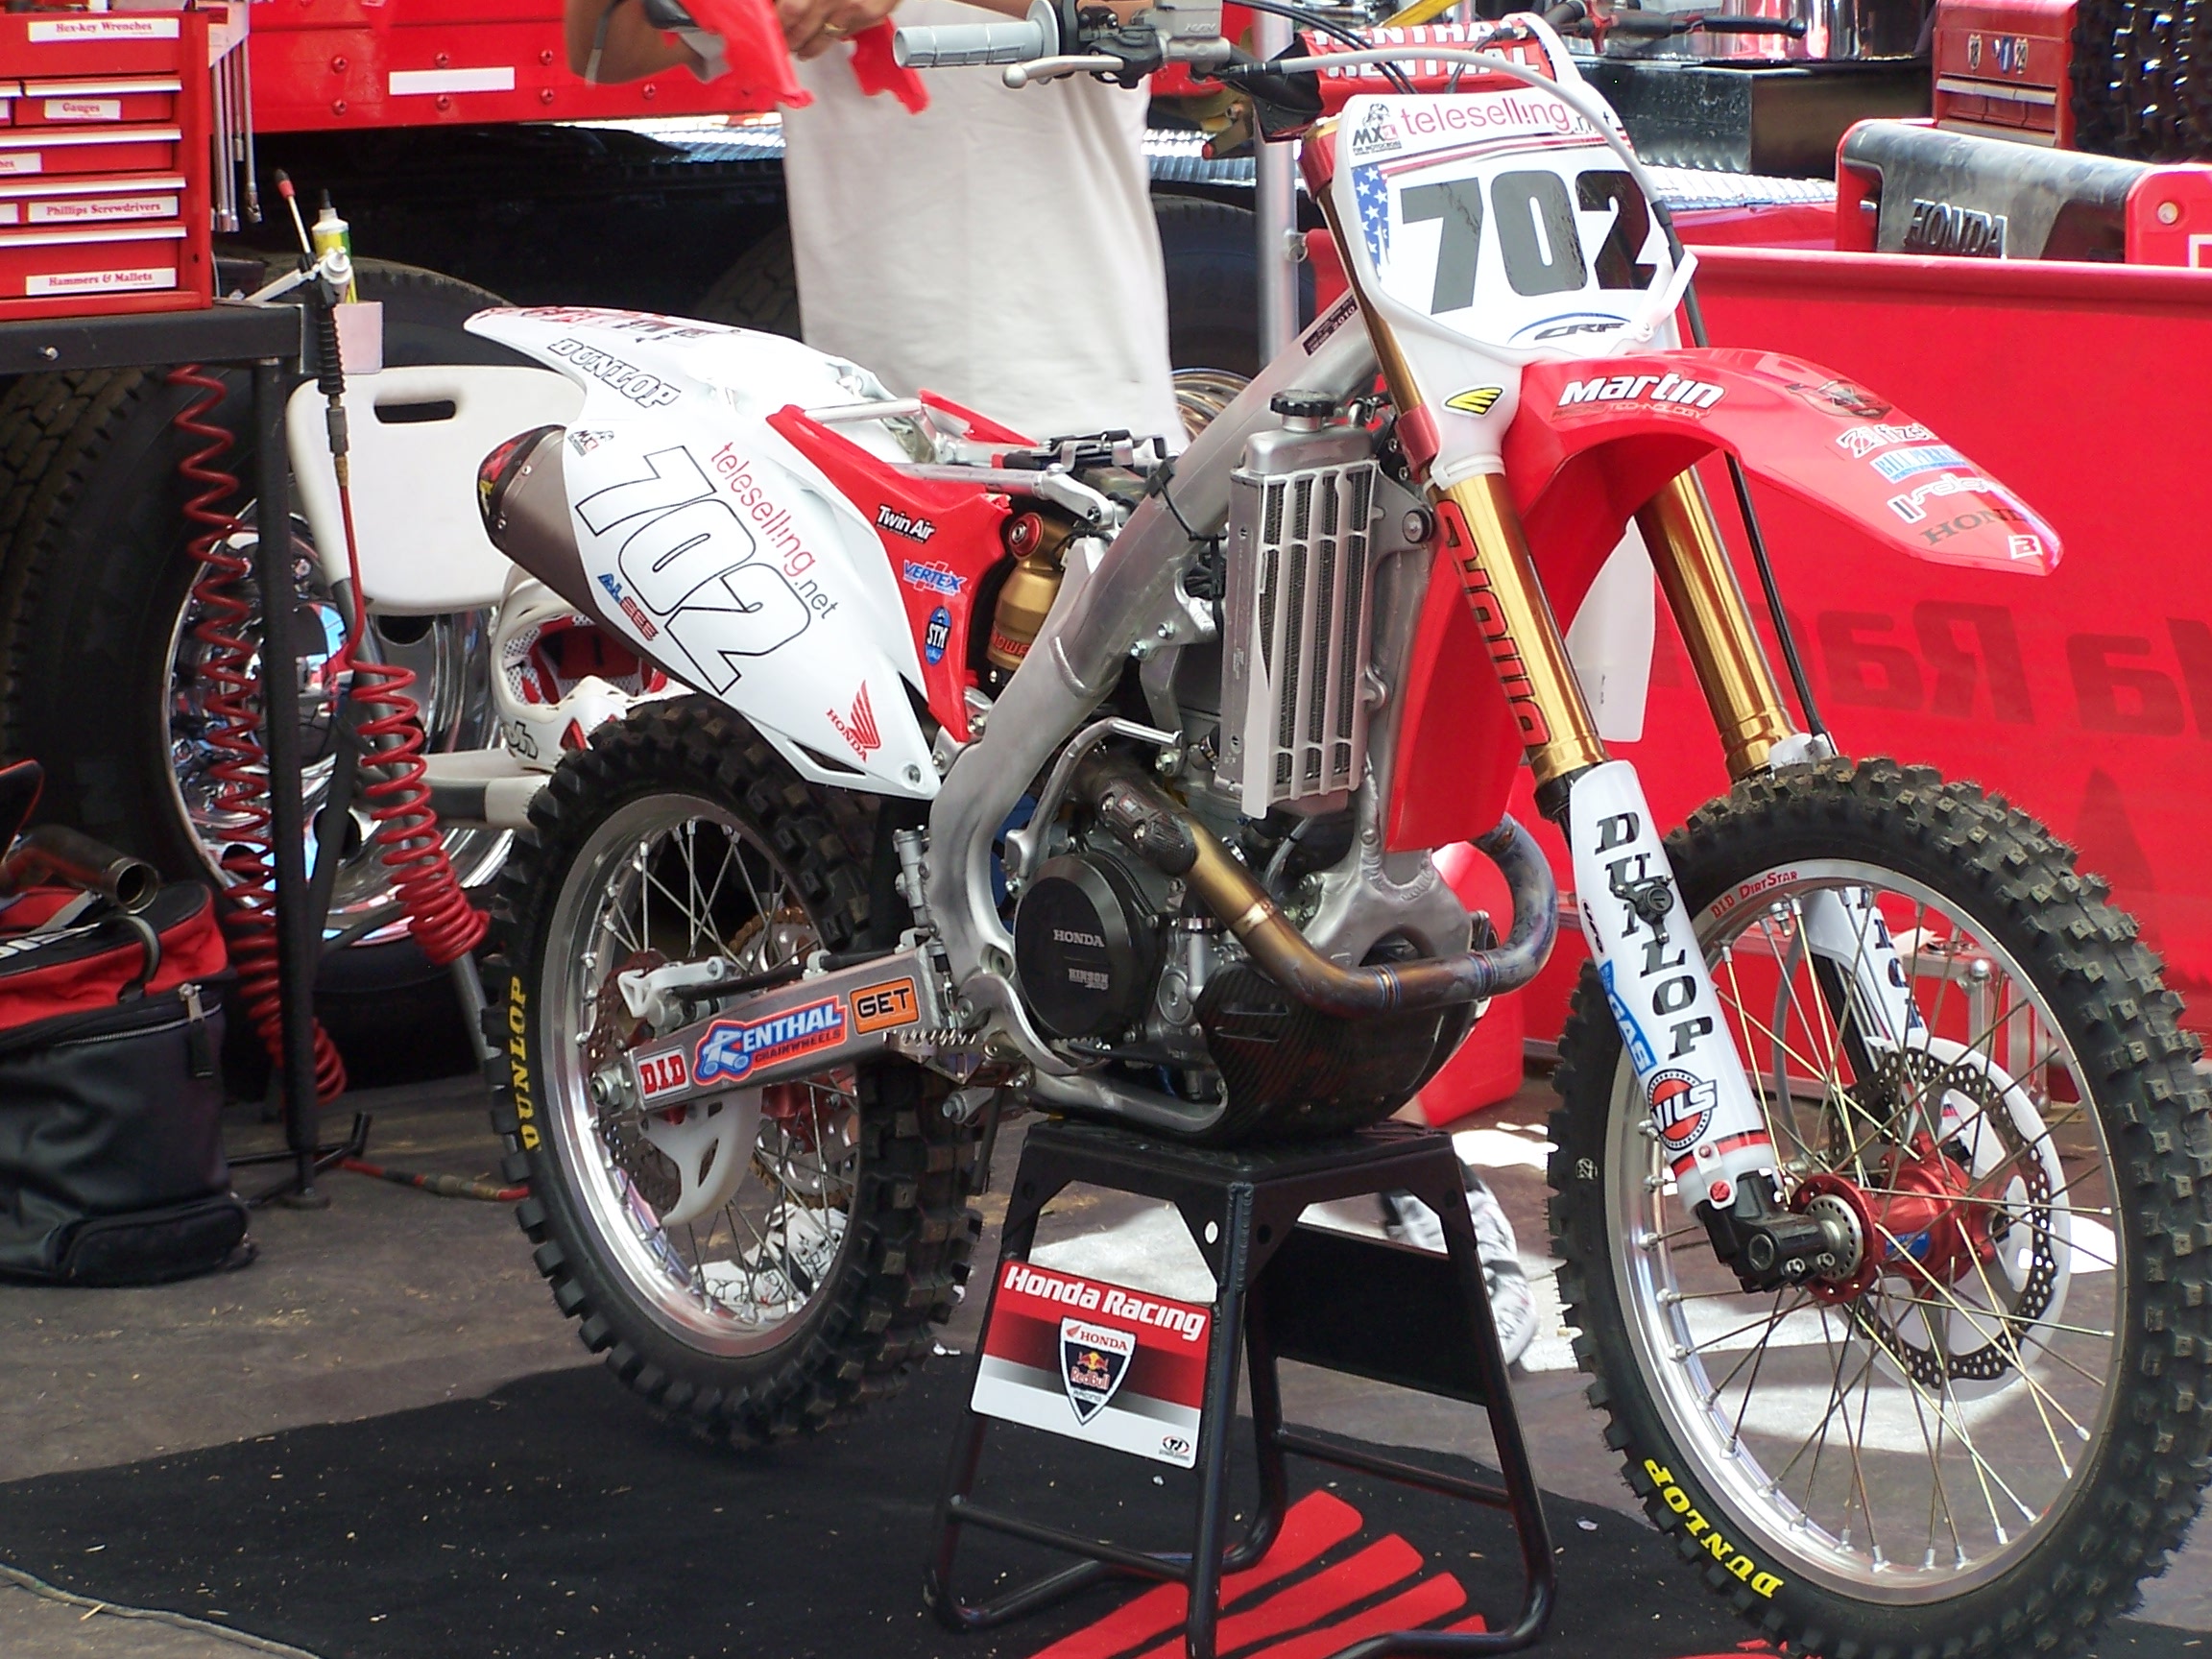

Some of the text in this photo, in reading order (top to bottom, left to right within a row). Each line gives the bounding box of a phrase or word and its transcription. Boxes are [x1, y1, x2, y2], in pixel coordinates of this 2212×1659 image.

[101, 22, 153, 32] Wrenches
[61, 102, 101, 114] Gauges
[46, 201, 161, 216] Phillips Screwdrivers
[1400, 170, 1657, 316] 702
[1903, 198, 2008, 258] HONDA
[48, 271, 154, 287] Hammers & Mallets
[547, 338, 682, 408] DUNLOP
[1557, 372, 1725, 409] Martin
[878, 506, 911, 531] Twin
[911, 519, 935, 541] Air
[576, 445, 811, 695] 702
[903, 560, 967, 591] VERTEX
[926, 623, 949, 649] STM
[827, 708, 867, 762] HONDA
[1711, 894, 1735, 919] DID
[1052, 928, 1105, 948] HONDA
[857, 987, 910, 1018] GET
[702, 1003, 842, 1077] RENTHAL
[755, 1029, 841, 1061] CHAINWHEELS
[509, 975, 541, 1152] DUNLOP
[1004, 1266, 1206, 1342] Honda Racing
[1080, 1331, 1128, 1352] HONDA
[1645, 1459, 1784, 1599] DUNLOP
